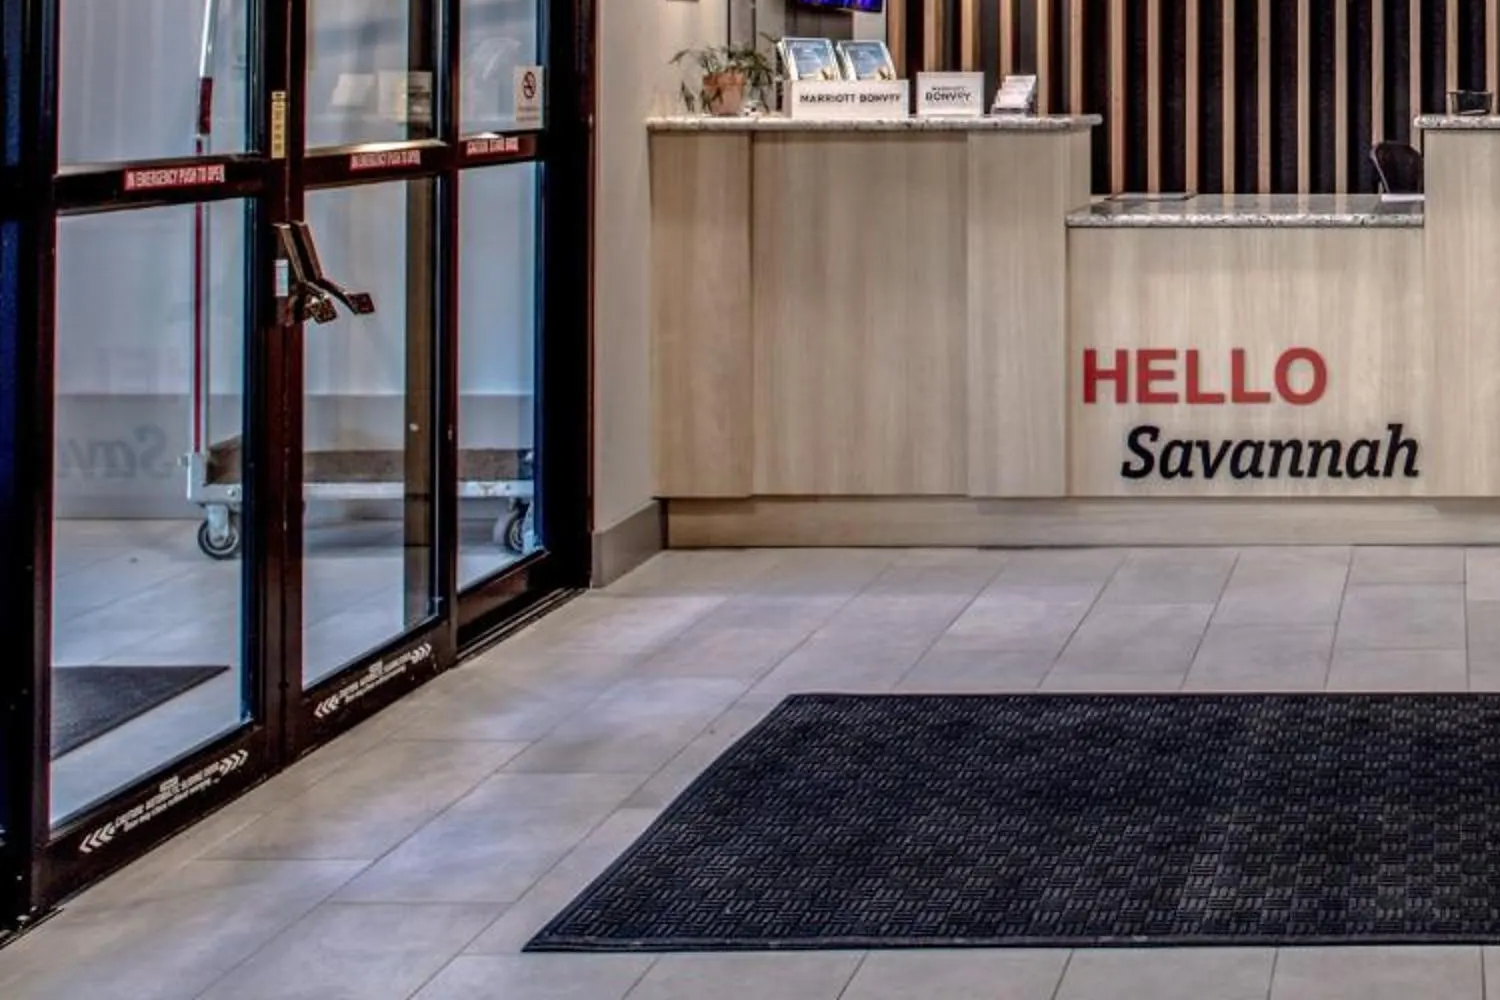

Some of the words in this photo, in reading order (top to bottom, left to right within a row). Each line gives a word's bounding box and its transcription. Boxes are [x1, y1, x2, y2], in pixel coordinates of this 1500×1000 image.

[800, 93, 855, 104] MARRIOTT
[1083, 347, 1328, 405] HELLO
[1121, 423, 1420, 479] Savannah
